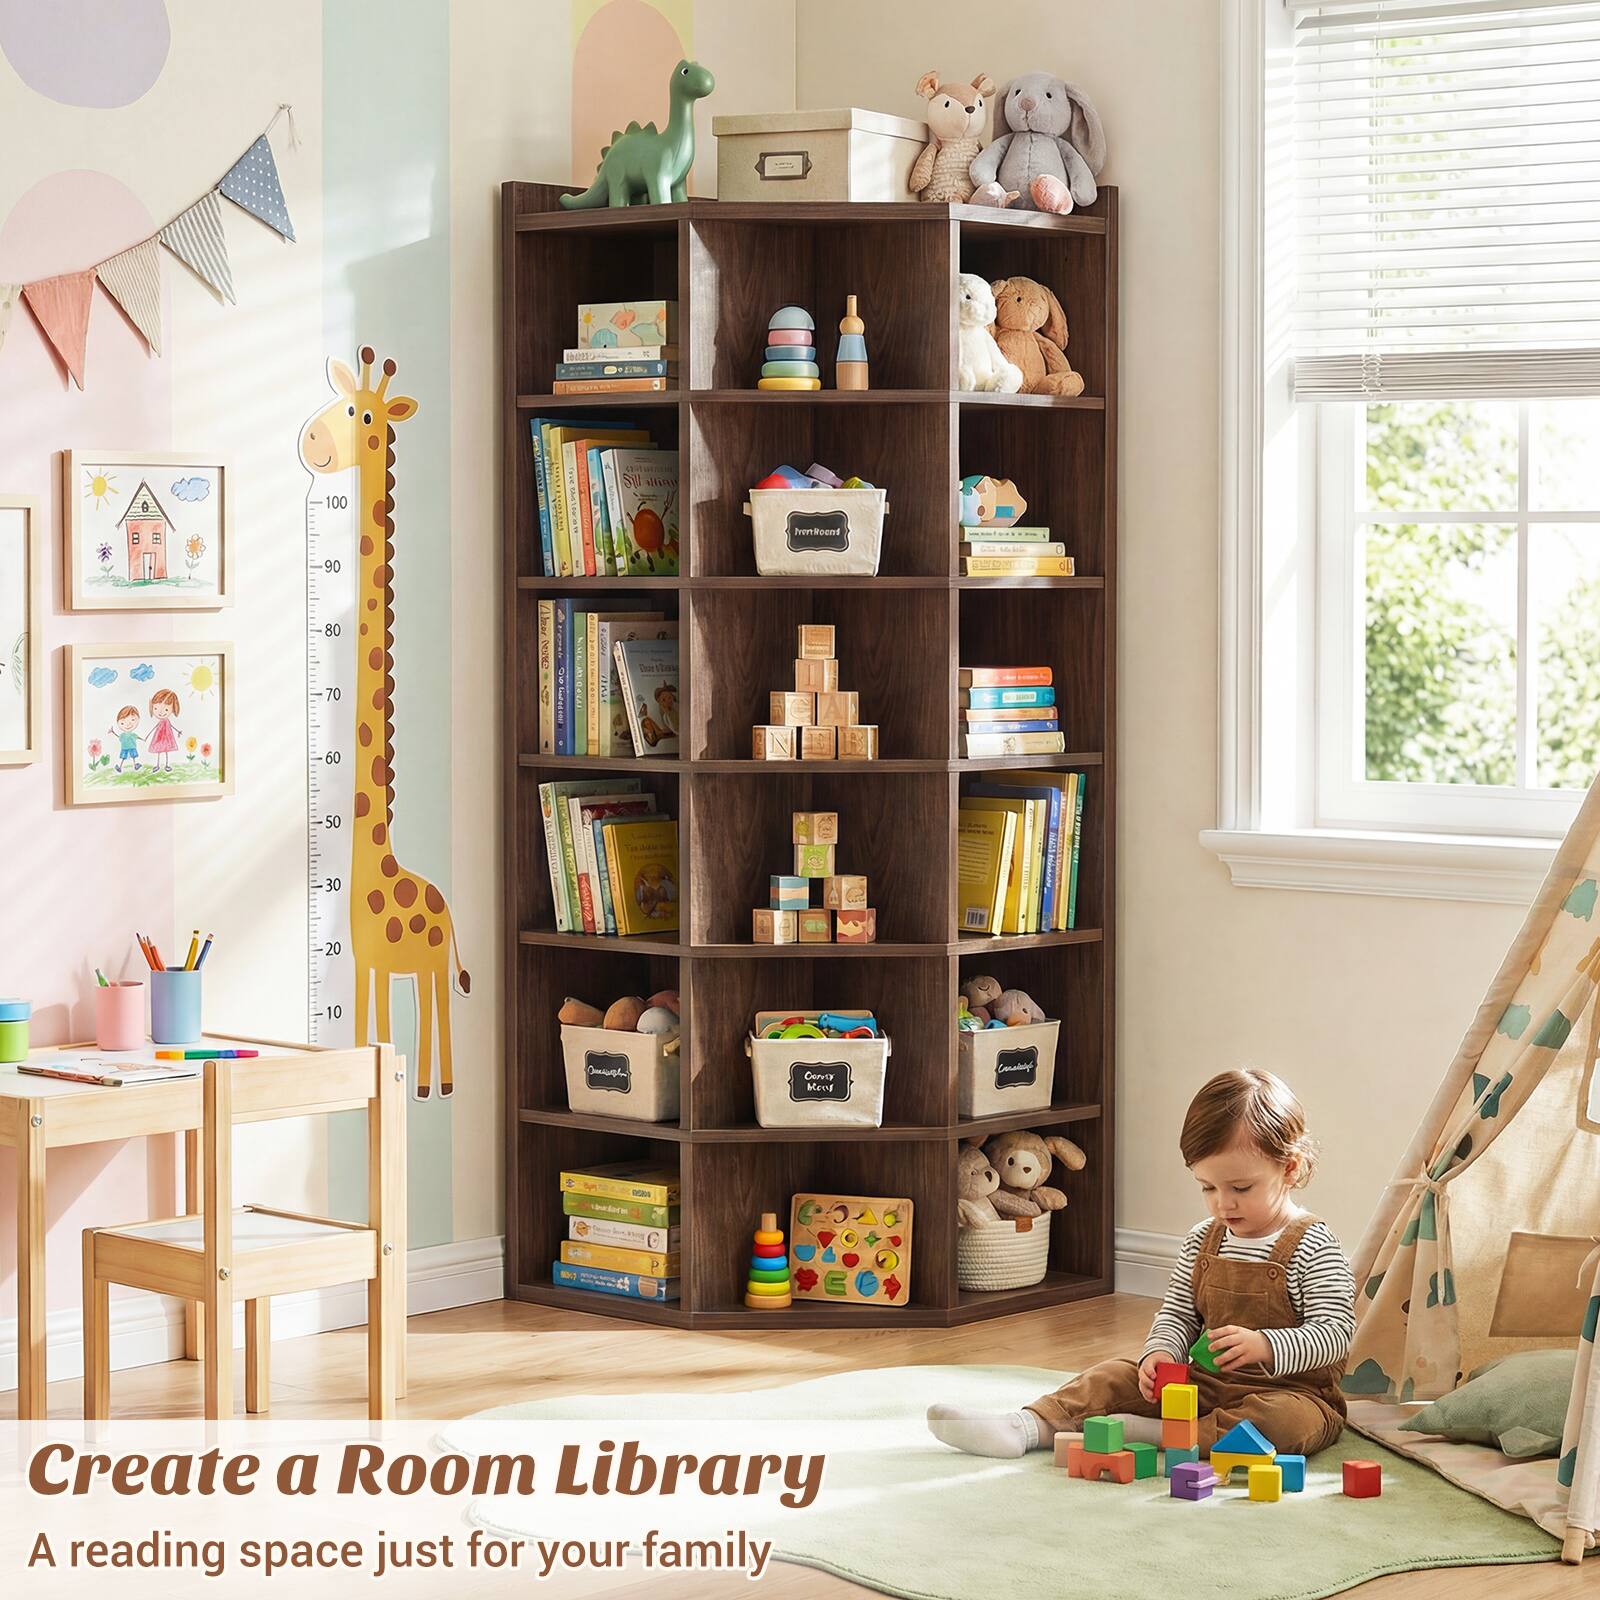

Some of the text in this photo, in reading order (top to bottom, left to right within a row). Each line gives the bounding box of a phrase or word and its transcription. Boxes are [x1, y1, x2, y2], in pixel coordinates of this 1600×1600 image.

[326, 495, 348, 510] 100
[325, 559, 341, 574] 90
[325, 623, 341, 638] 80
[325, 687, 342, 702] 70
[325, 750, 342, 765] 60
[325, 814, 342, 829] 50
[325, 877, 342, 893] 30
[325, 941, 342, 957] 20
[326, 1004, 342, 1020] 10
